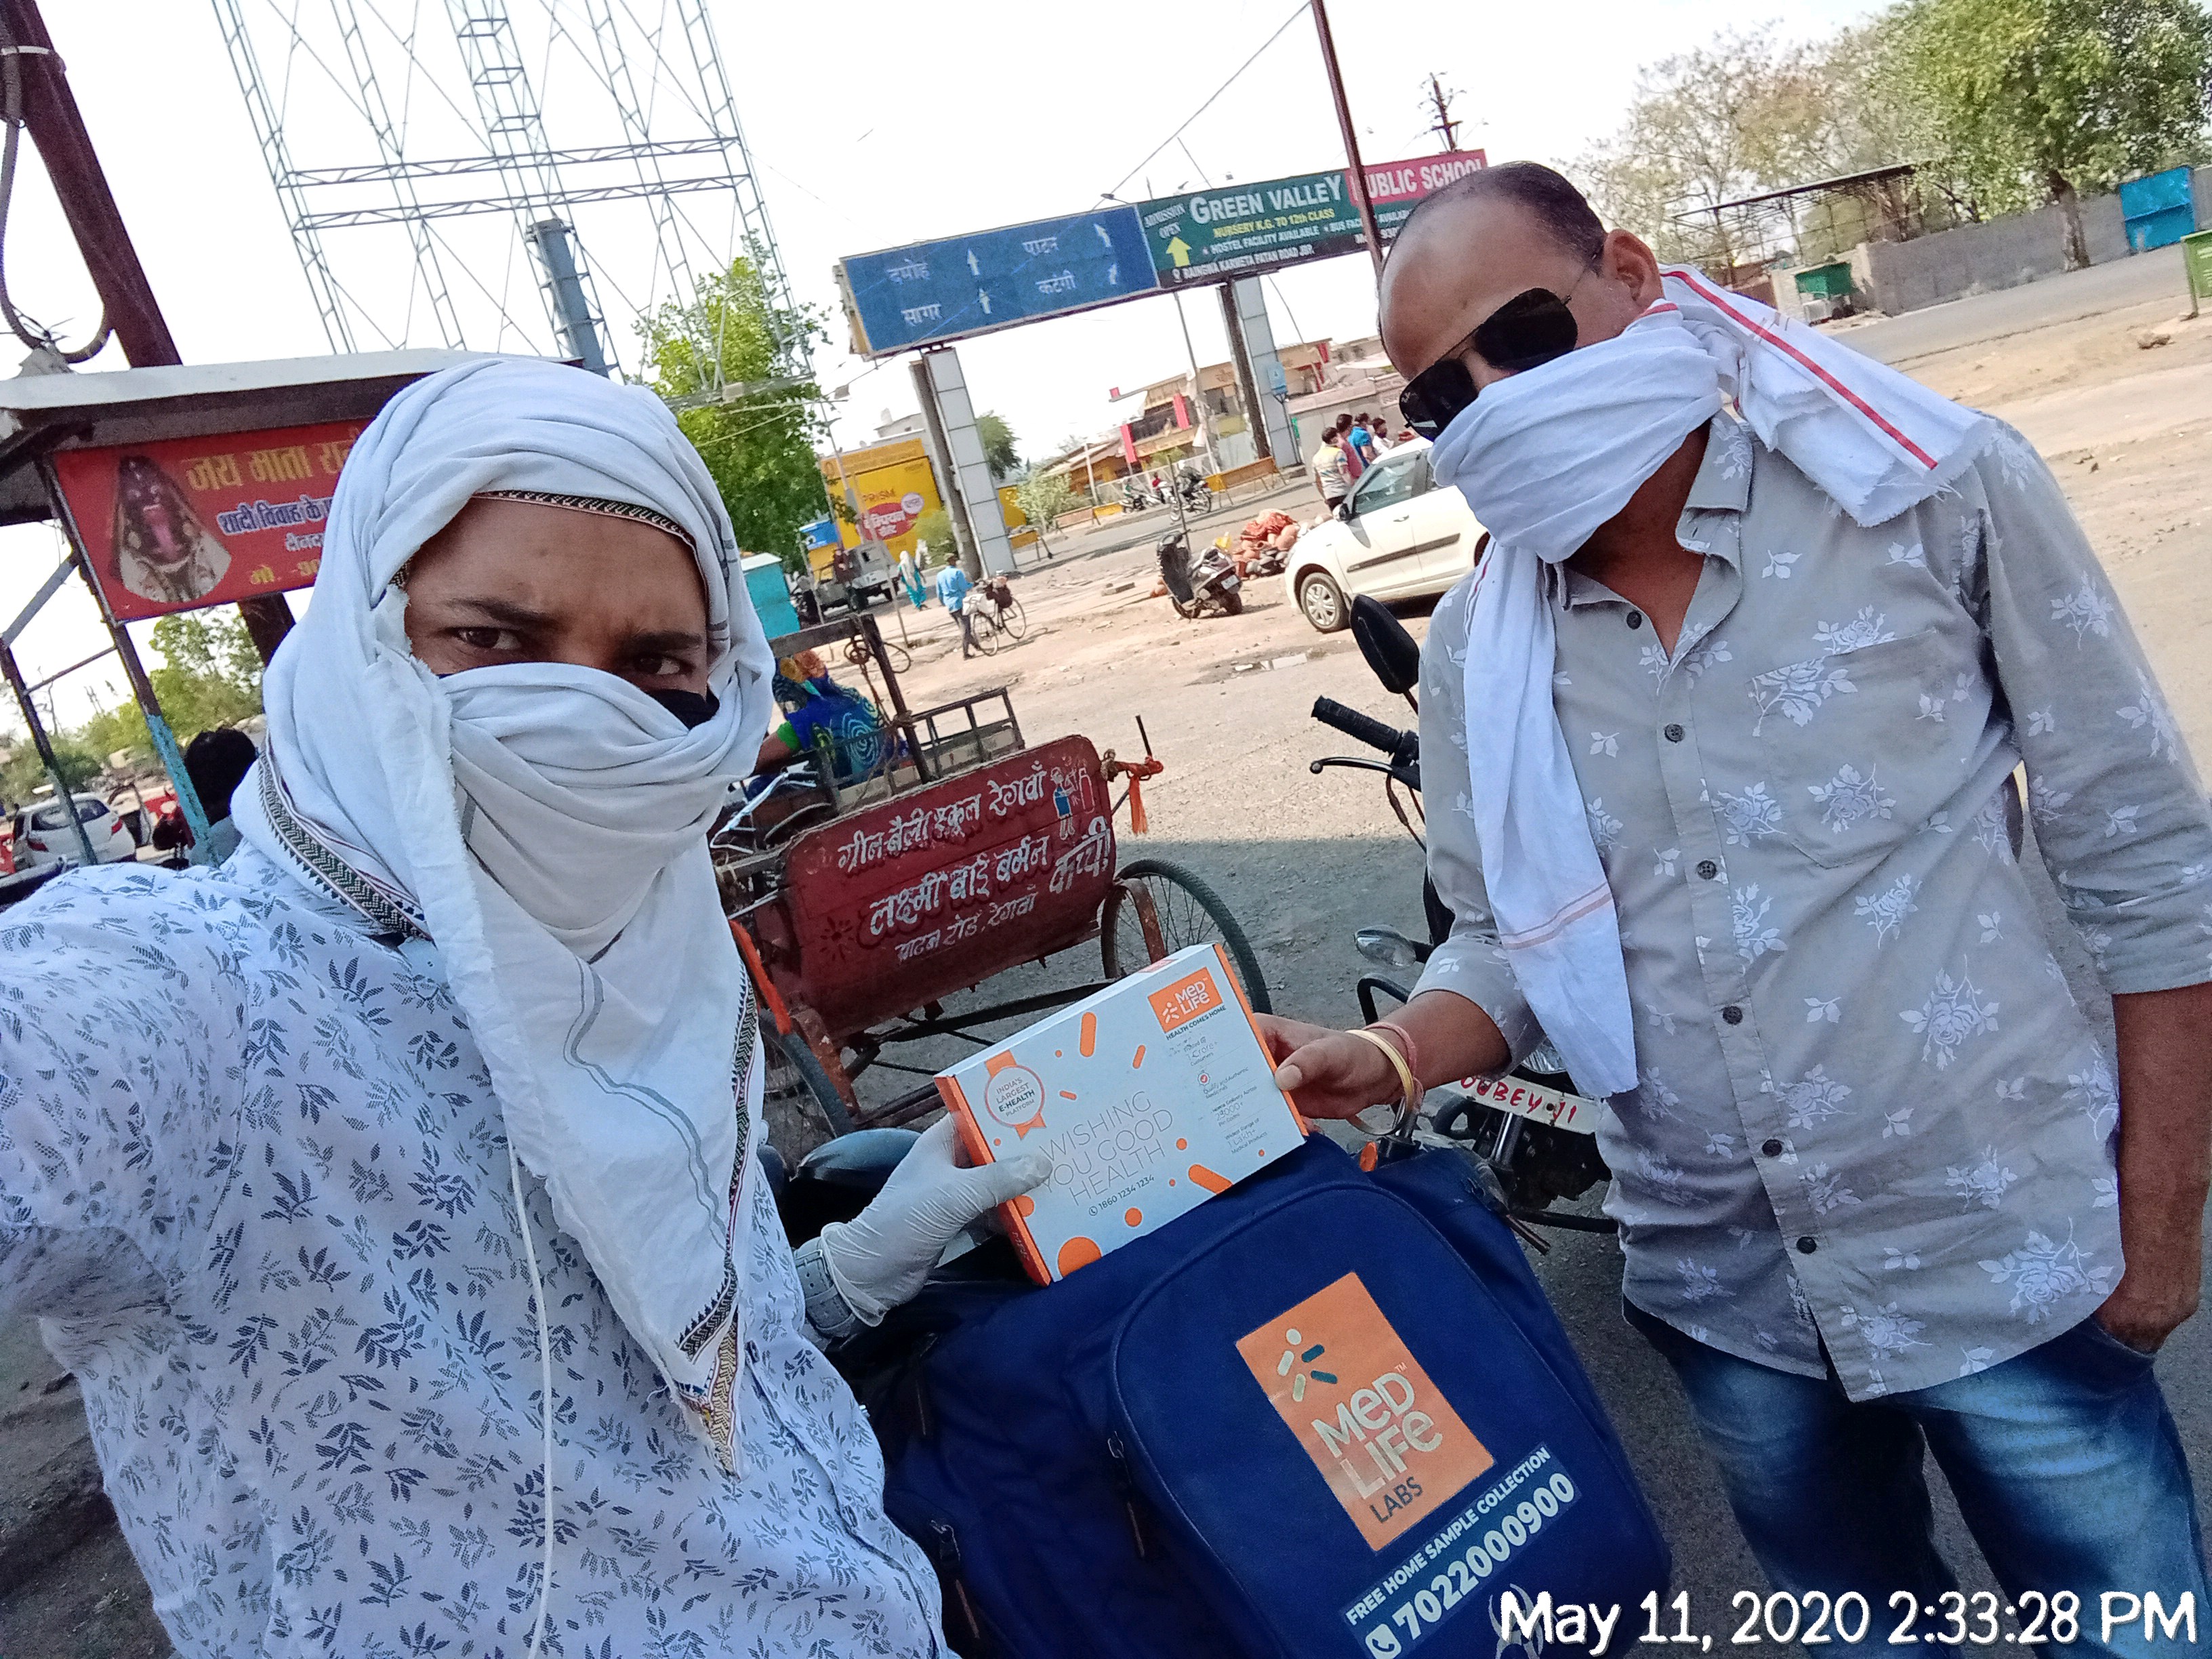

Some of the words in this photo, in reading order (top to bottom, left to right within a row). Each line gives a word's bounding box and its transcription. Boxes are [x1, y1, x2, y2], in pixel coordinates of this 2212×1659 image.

[1189, 197, 1265, 224] GREEN
[1267, 175, 1342, 211] VALLEY
[1350, 169, 1417, 201] UBLIC
[1159, 222, 1181, 239] OPEN
[1210, 239, 1243, 255] HOSTEL
[1242, 233, 1277, 247] FACILITY
[1278, 225, 1320, 242] AVAILABLE
[1213, 222, 1254, 238] NURSERY
[1275, 216, 1288, 227] TO
[1307, 207, 1335, 222] CLASS
[1022, 237, 1059, 255] पाटन
[1277, 247, 1299, 260] ROAD
[1035, 270, 1078, 294] कटंगी
[901, 304, 944, 327] सागर
[244, 445, 313, 483] माता
[217, 502, 255, 535] शादी
[254, 500, 306, 529] विवाह
[300, 495, 323, 522] के
[838, 829, 885, 873] ग्रीन
[869, 872, 948, 936] लक्ष्मी
[949, 853, 990, 899] बाई
[994, 836, 1050, 882] बर्मन
[1166, 1025, 1189, 1040] HEALTH
[1189, 1015, 1209, 1029] COMES
[1210, 1005, 1227, 1017] HOME
[1190, 1052, 1214, 1066] Customers
[996, 1077, 1023, 1094] INDIA'S
[996, 1082, 1029, 1104] LARGEST
[998, 1089, 1035, 1112] E-HEALTH
[1006, 1099, 1035, 1117] PLATFORM
[1039, 1091, 1151, 1161] WISHING
[1098, 1109, 1172, 1161] GOOD
[1069, 1139, 1165, 1206] HEALTH
[1099, 1195, 1118, 1210] 1860
[1118, 1185, 1136, 1199] 1234
[1136, 1174, 1154, 1188] 1234
[1370, 1476, 1423, 1523] LABS
[1345, 1589, 1387, 1626] FREE
[1382, 1551, 1429, 1593] HOME
[1425, 1509, 1479, 1560] SAMPLE
[1477, 1447, 1551, 1513] COLLECTION
[1392, 1473, 1576, 1640] 7022000900
